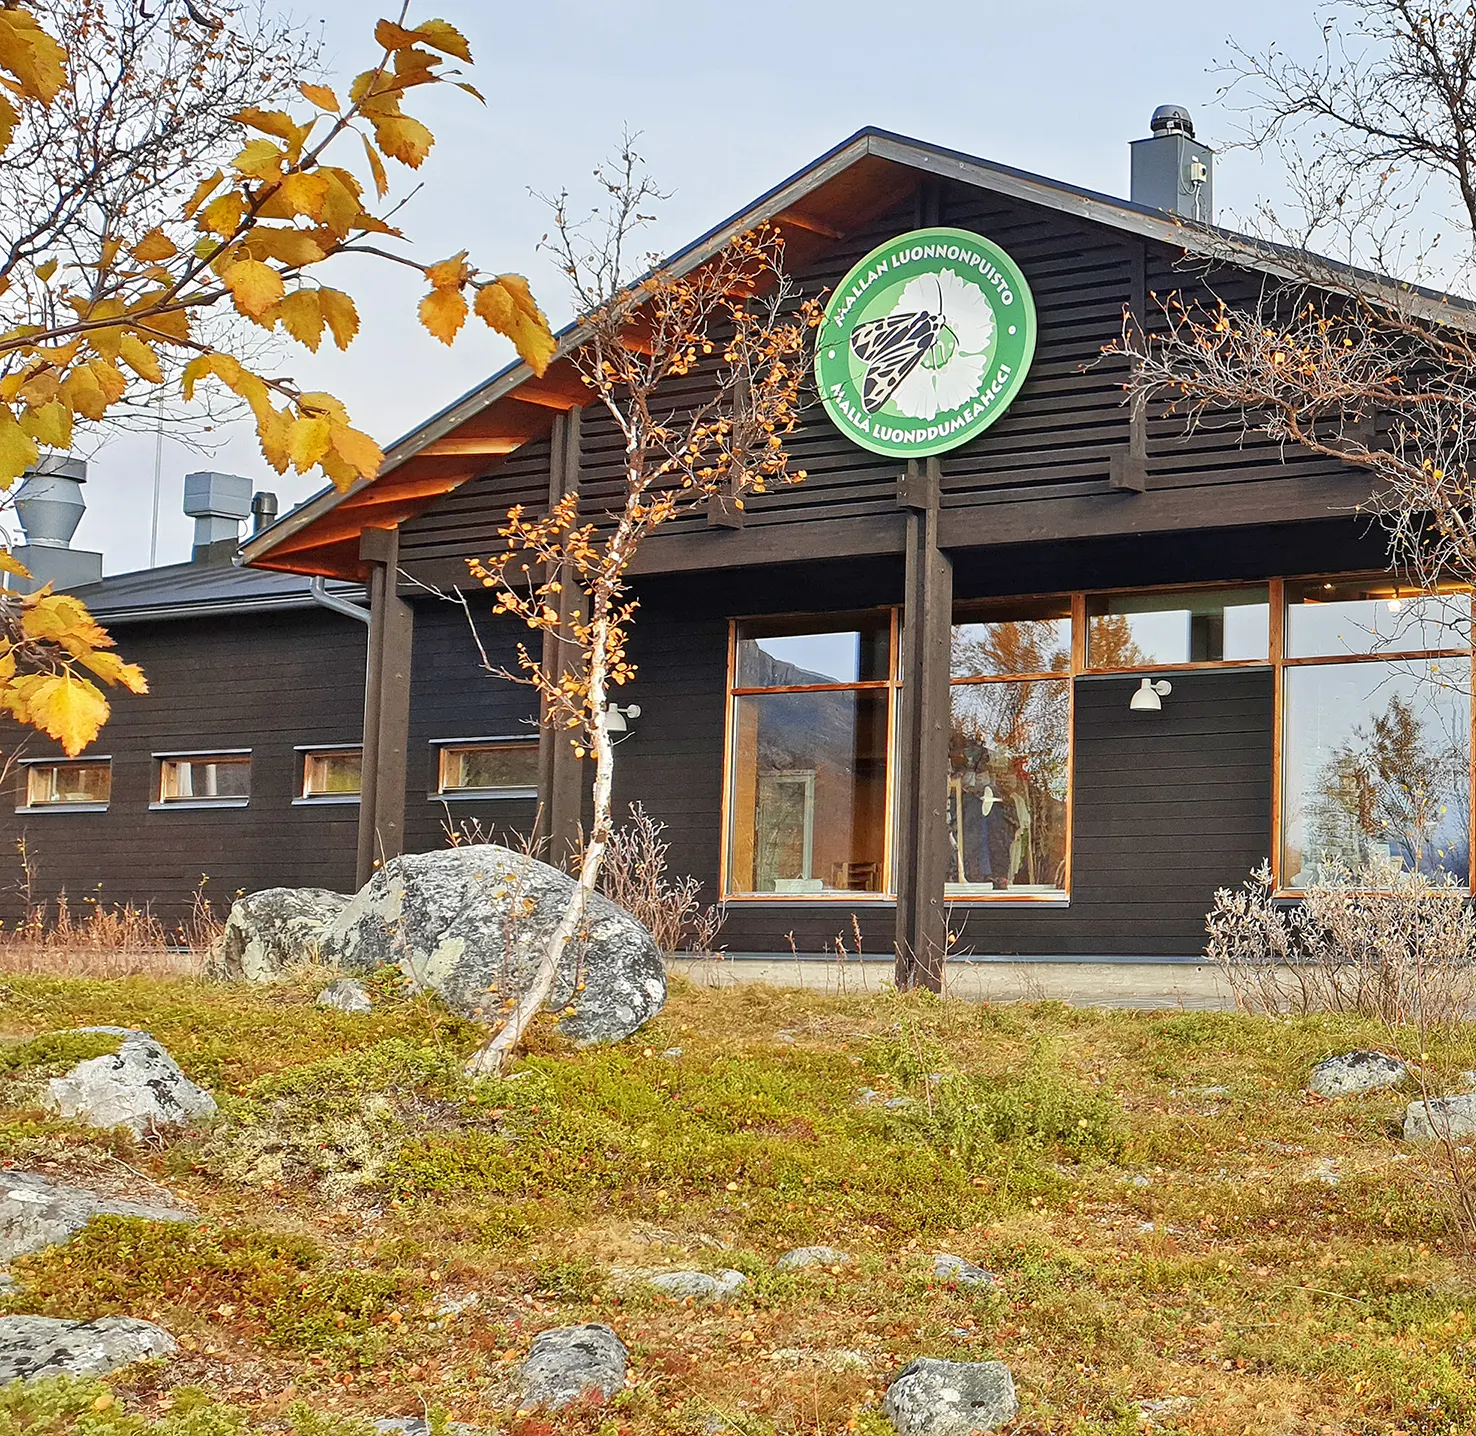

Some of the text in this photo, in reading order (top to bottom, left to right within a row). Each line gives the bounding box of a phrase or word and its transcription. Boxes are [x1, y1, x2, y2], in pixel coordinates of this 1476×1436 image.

[834, 244, 1014, 327] MALLAN LUONNONPUISTO
[830, 364, 1012, 444] MALLÁ LUONDDUMEAHCCI
